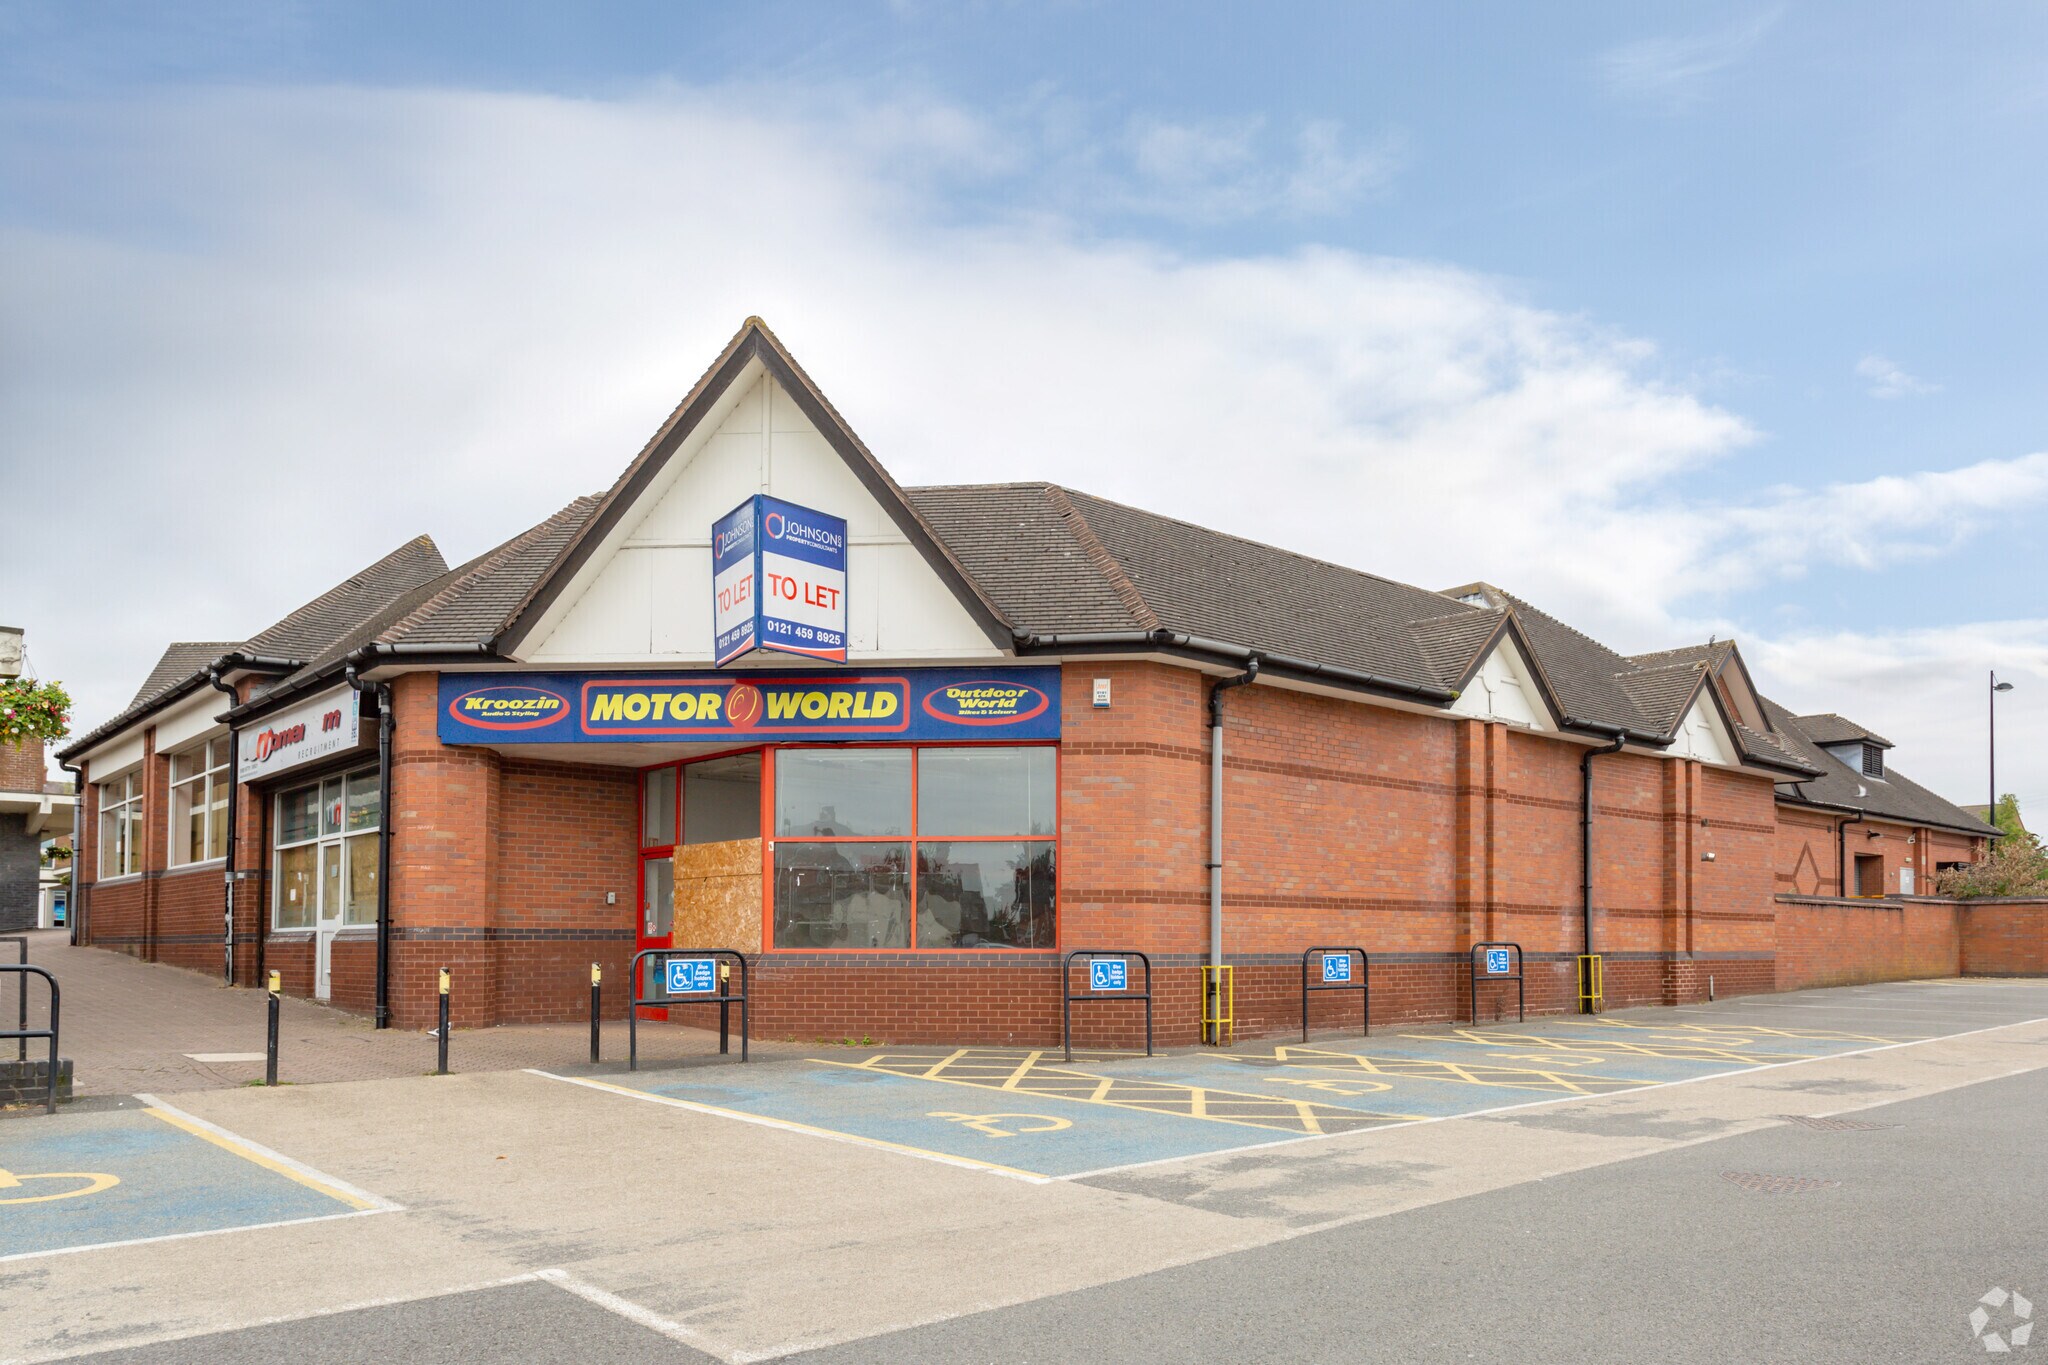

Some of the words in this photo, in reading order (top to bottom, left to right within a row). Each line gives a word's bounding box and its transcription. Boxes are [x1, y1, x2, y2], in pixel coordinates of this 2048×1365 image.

[786, 520, 838, 547] JOHNSON
[718, 588, 731, 614] TO
[734, 574, 753, 606] LET
[768, 573, 797, 601] TO
[805, 582, 840, 611] LET
[718, 634, 731, 650] 0121
[767, 620, 792, 635] 0121
[795, 626, 814, 640] 459
[816, 631, 841, 645] 8925
[465, 696, 560, 710] Kroozin
[946, 688, 1028, 699] Outdoor
[957, 698, 1017, 709] World
[590, 692, 722, 721] MOTOR
[767, 691, 898, 720] WORLD
[298, 737, 340, 760] RECRUITMENT
